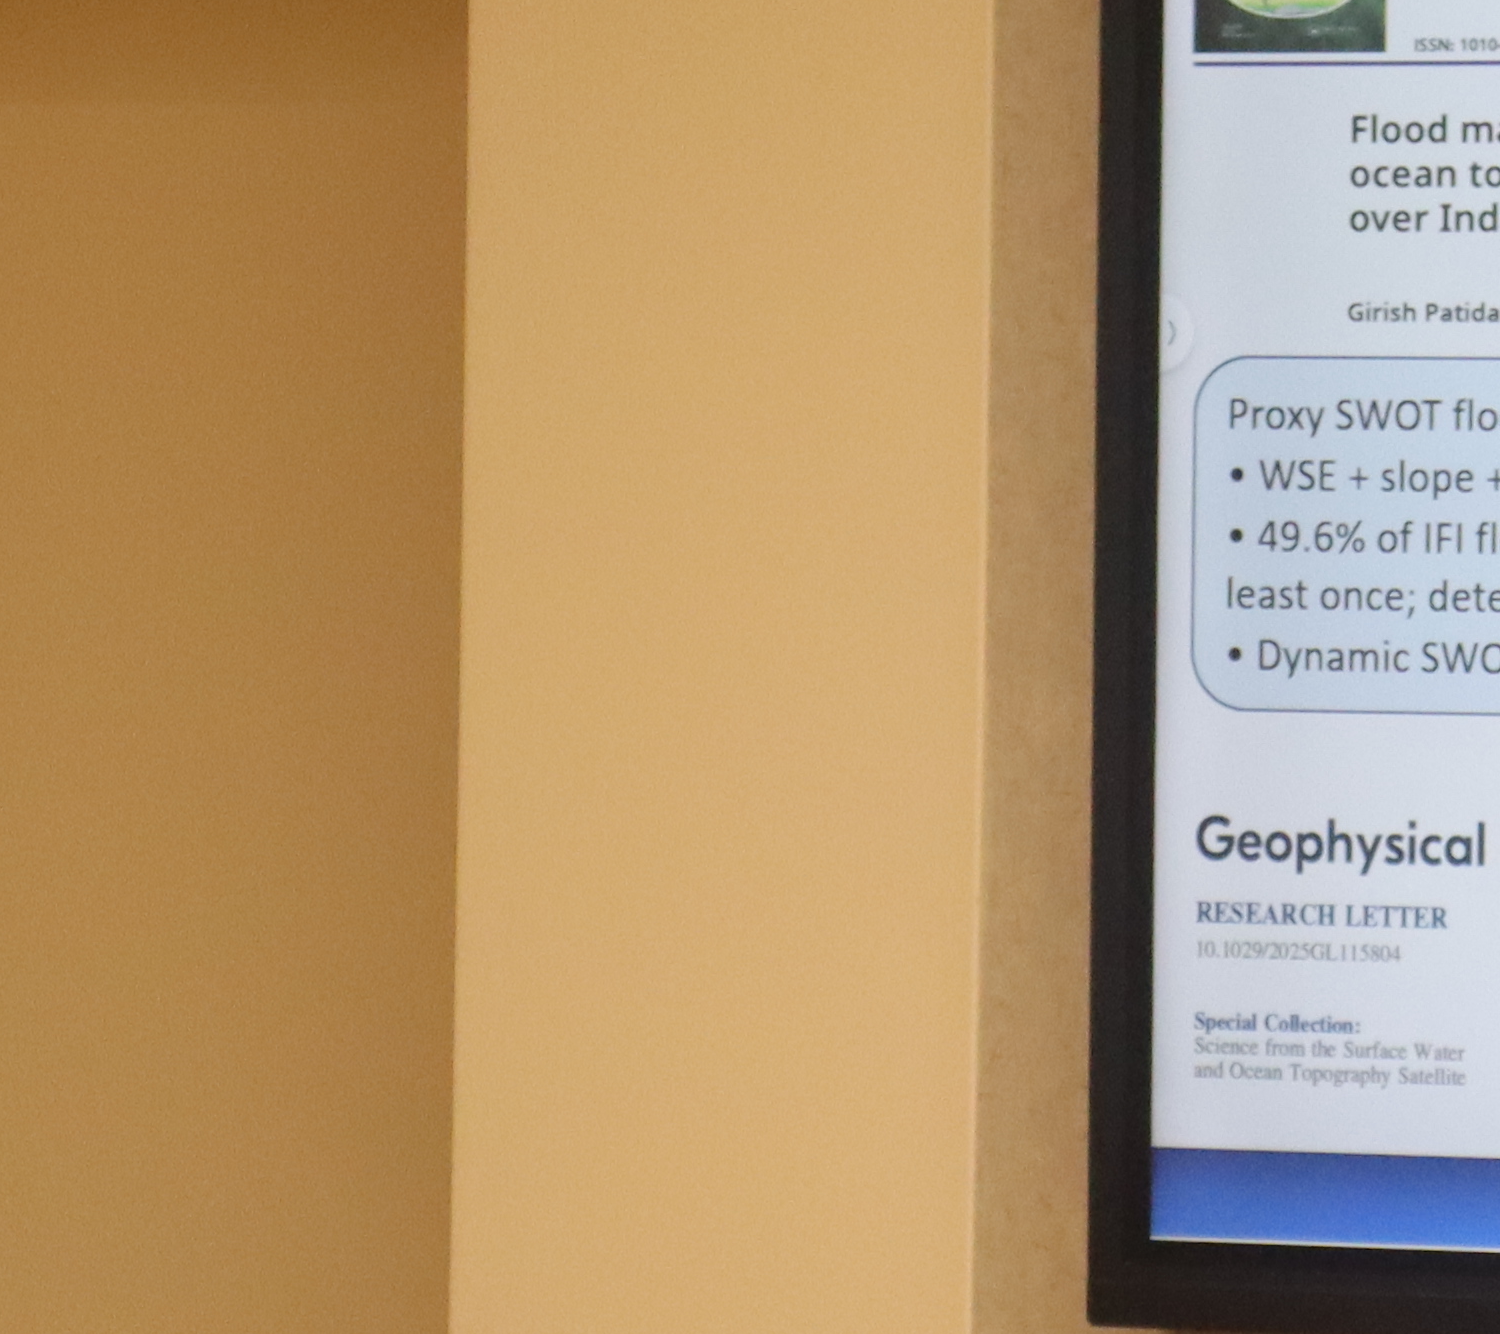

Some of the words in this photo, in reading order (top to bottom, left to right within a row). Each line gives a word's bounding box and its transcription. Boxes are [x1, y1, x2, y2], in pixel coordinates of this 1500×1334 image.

[1351, 113, 1449, 145] Flood
[1349, 164, 1458, 190] ocean
[1348, 209, 1430, 233] over
[1228, 397, 1326, 439] Proxy
[1336, 398, 1444, 432] SWOT
[1257, 519, 1367, 554] 49.6%
[1376, 520, 1415, 555] of
[1424, 521, 1464, 555] IFI
[1195, 813, 1487, 876] Geophysical
[1196, 900, 1336, 927] RESEARCH
[1345, 904, 1449, 931] LETTER
[1194, 1011, 1258, 1034] Special
[1263, 1012, 1361, 1035] Collection:
